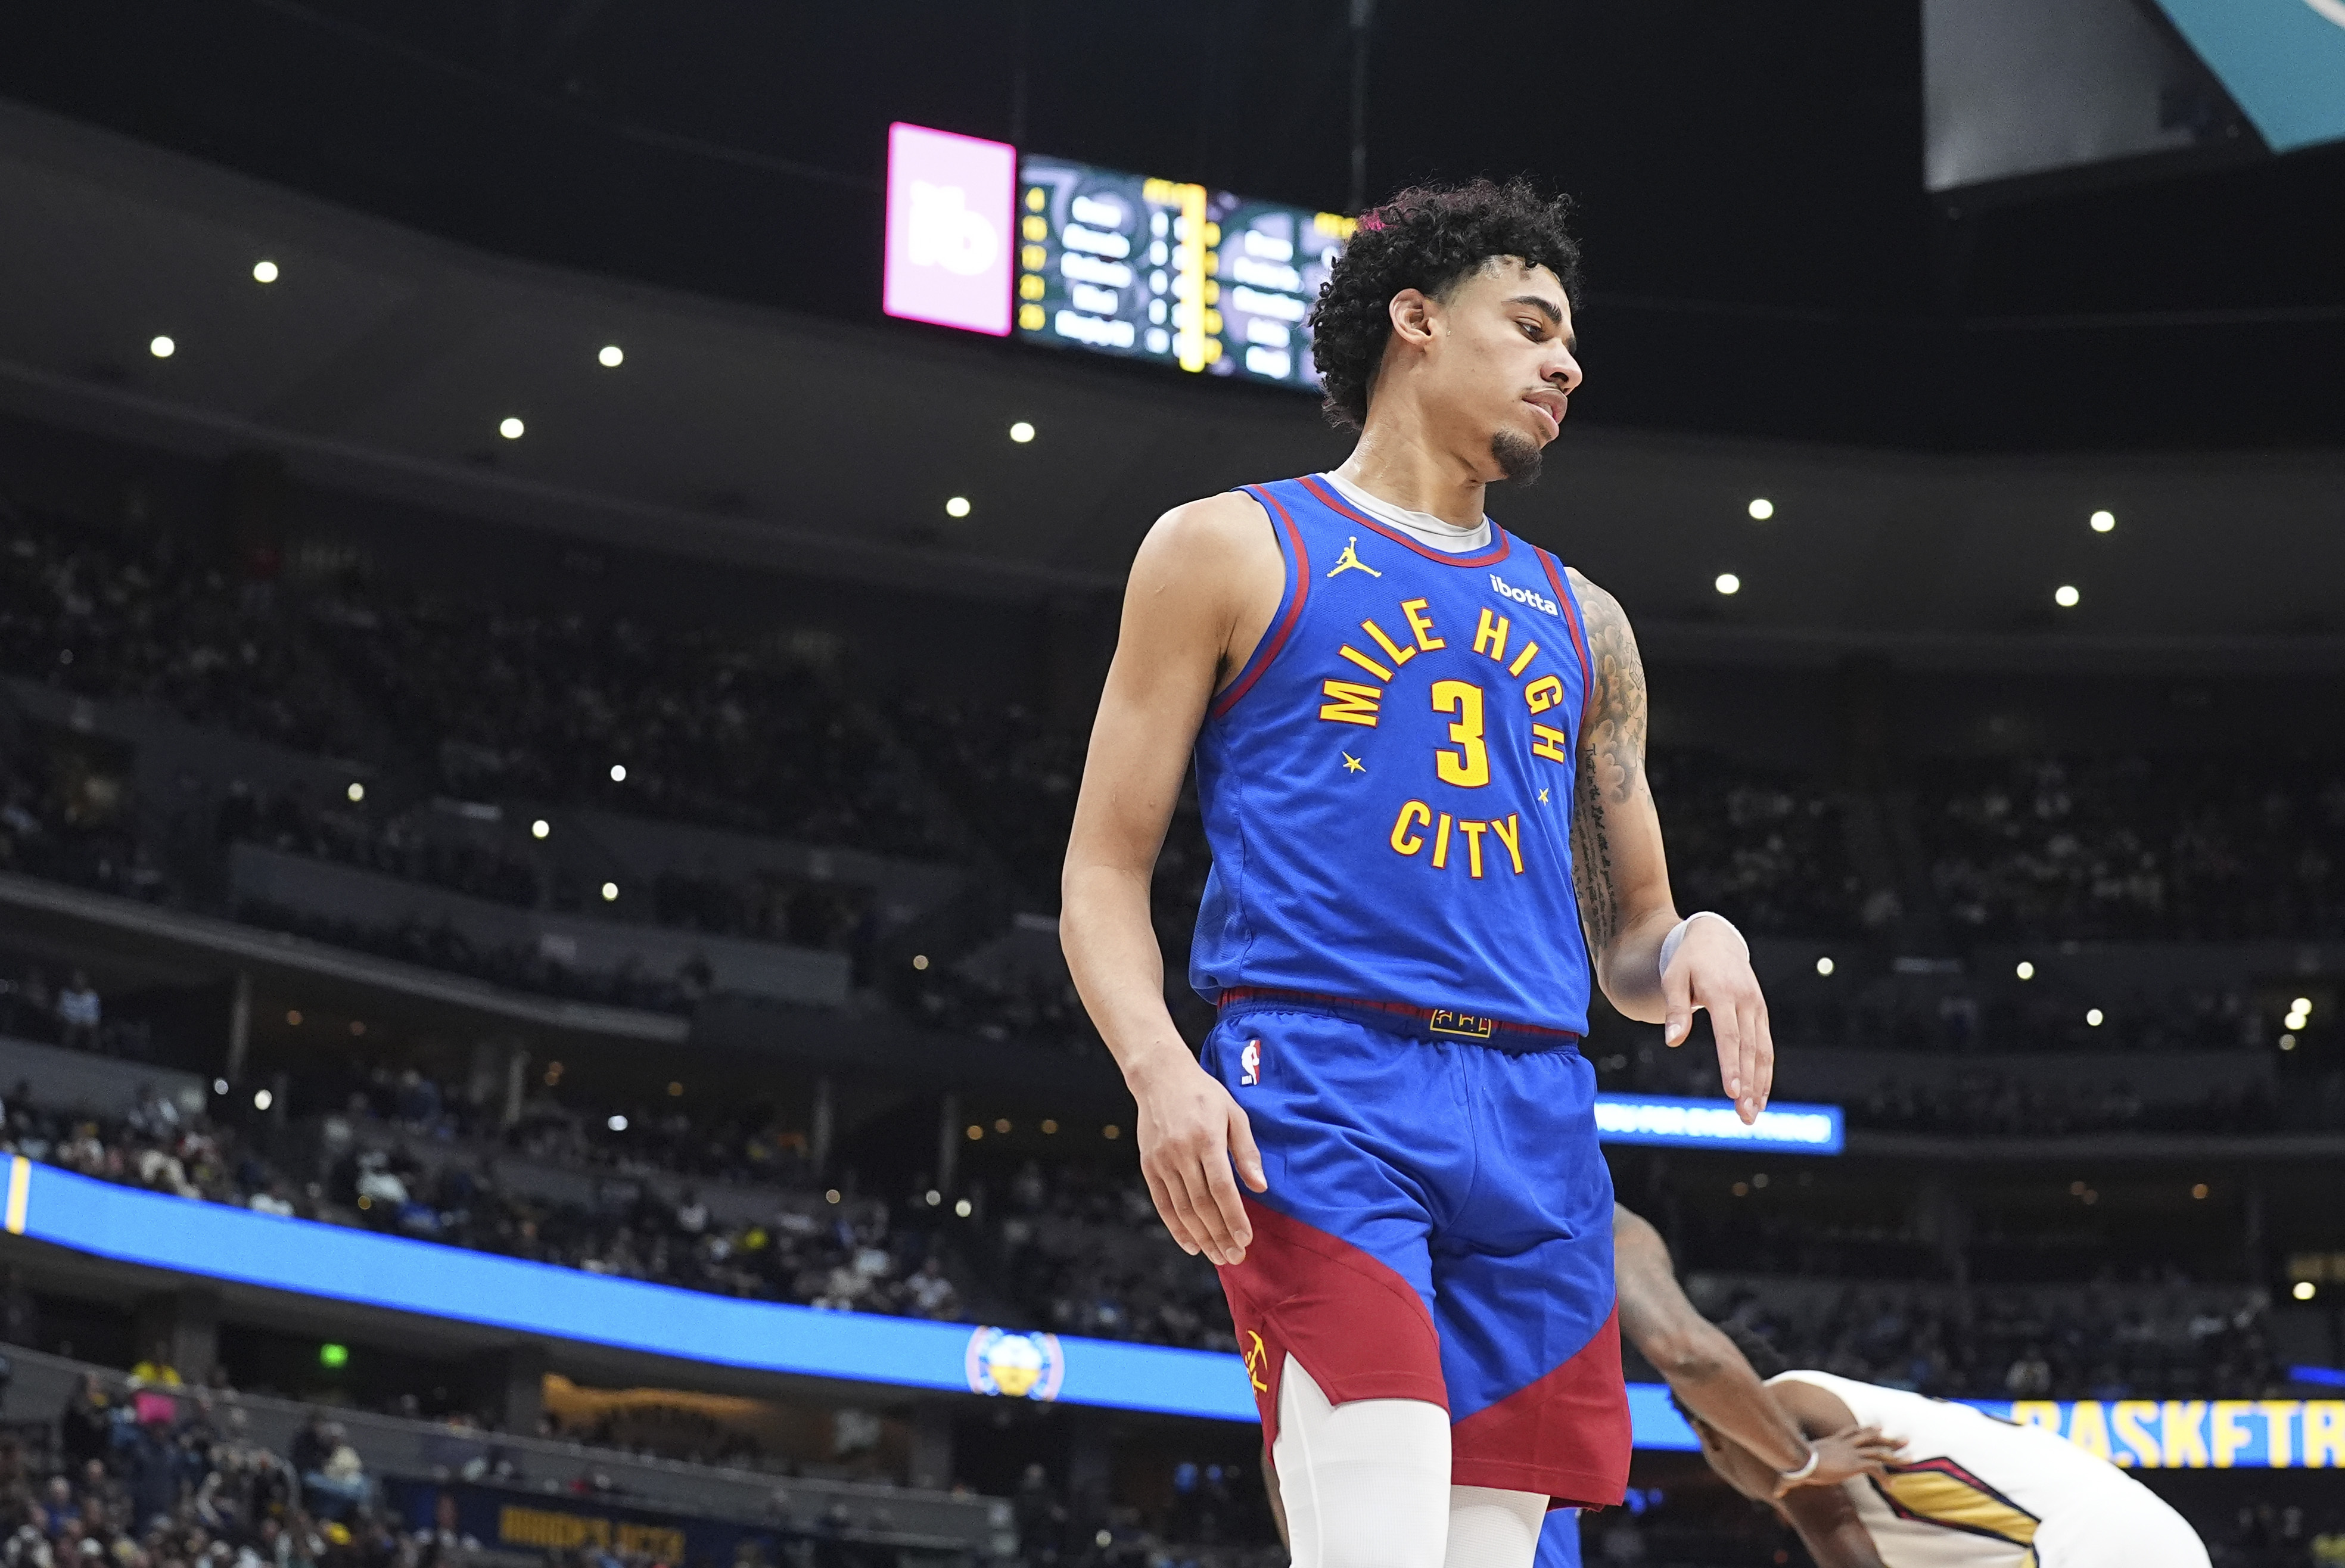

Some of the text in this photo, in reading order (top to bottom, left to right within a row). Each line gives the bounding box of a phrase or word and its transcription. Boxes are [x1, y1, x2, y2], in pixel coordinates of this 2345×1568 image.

[1489, 573, 1559, 616] ibotta
[1318, 598, 1565, 764] MILE HIGH
[1431, 679, 1490, 789] 3
[1390, 799, 1524, 878] CITY
